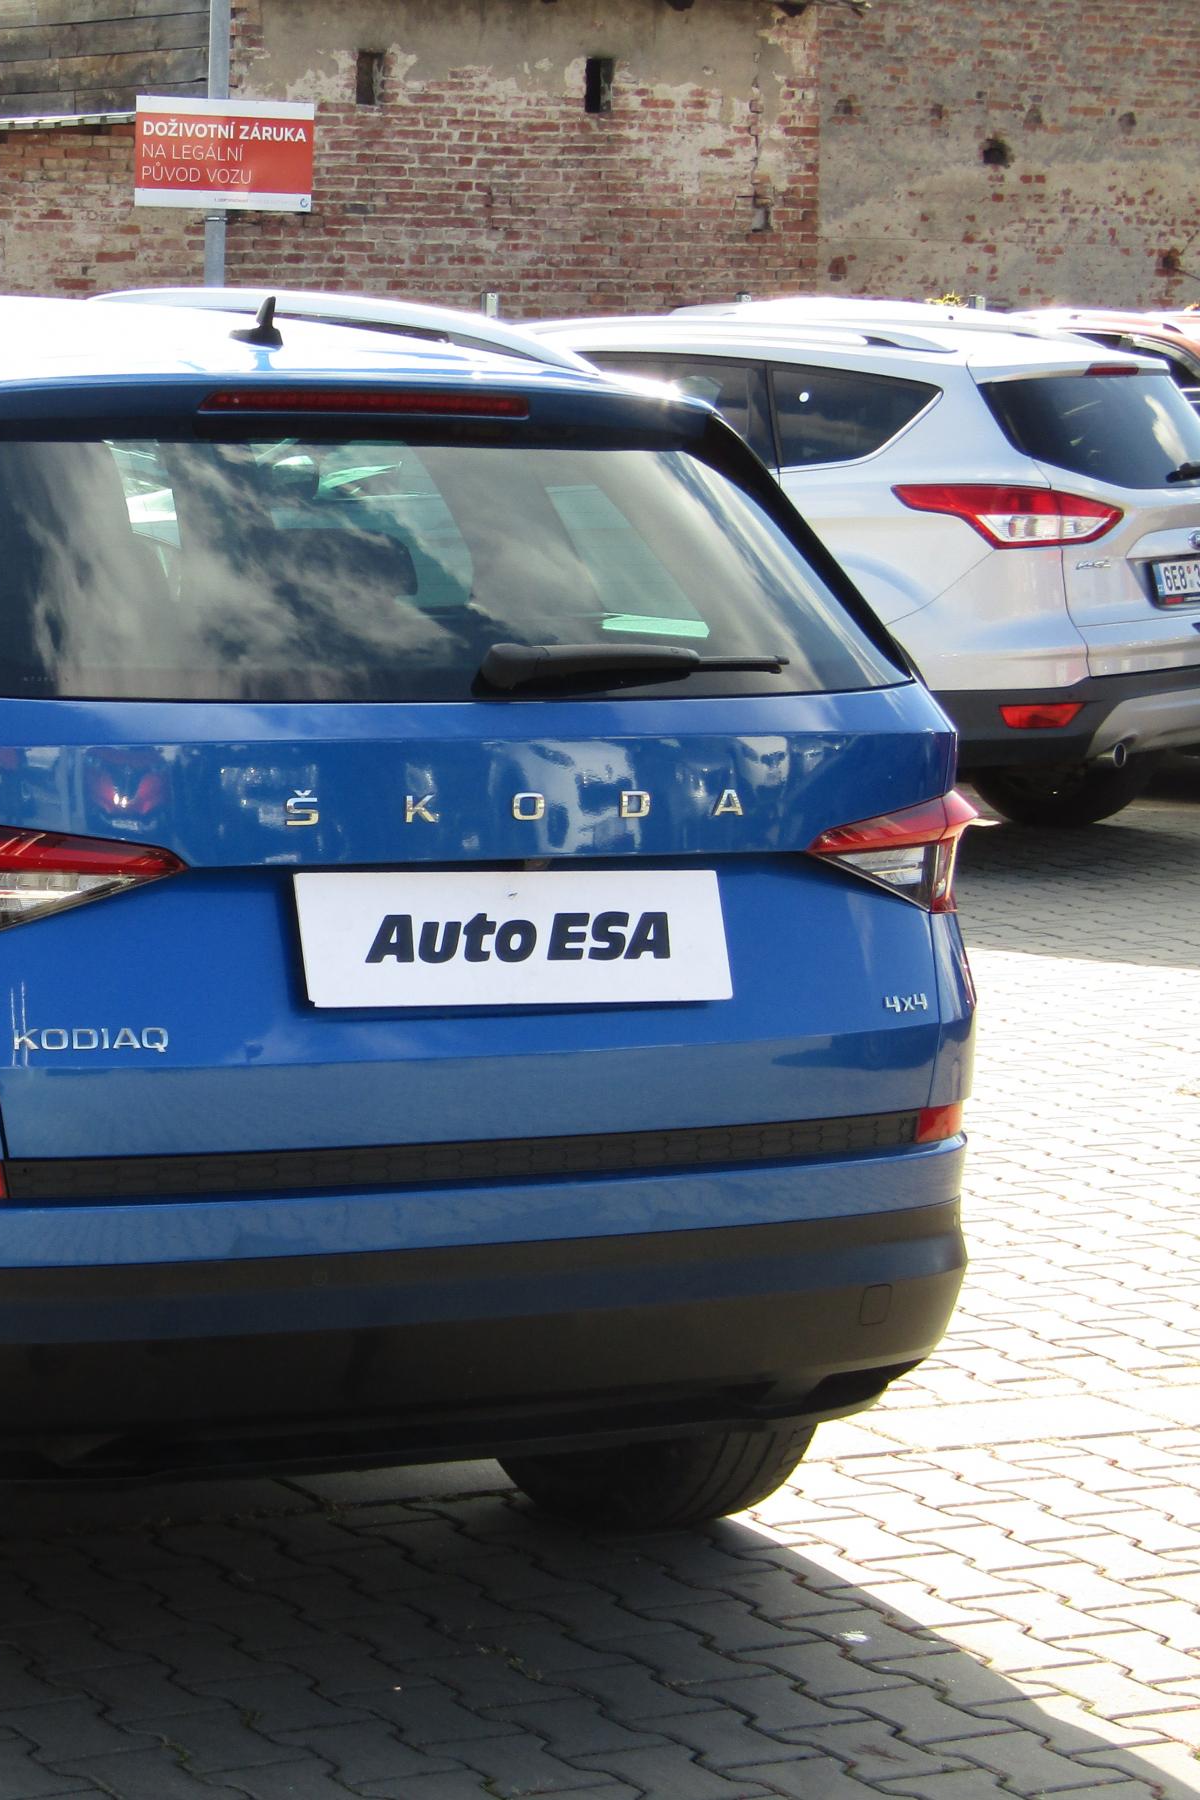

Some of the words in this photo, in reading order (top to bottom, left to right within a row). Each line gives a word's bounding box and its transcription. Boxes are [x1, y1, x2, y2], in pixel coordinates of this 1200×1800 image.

[143, 119, 235, 140] DOŽIVOTNÍ
[239, 123, 307, 143] ZÁRUKA
[142, 143, 166, 159] NA
[172, 141, 244, 162] LEGÁLNÍ
[141, 161, 200, 183] PŮVOD
[206, 168, 252, 185] VOZU
[1163, 565, 1188, 591] 6E8
[286, 789, 744, 826] ŠKODA
[365, 912, 537, 964] Auto
[546, 911, 671, 961] ESA
[884, 993, 928, 1013] 4x4
[13, 1027, 169, 1053] KODIAQ
